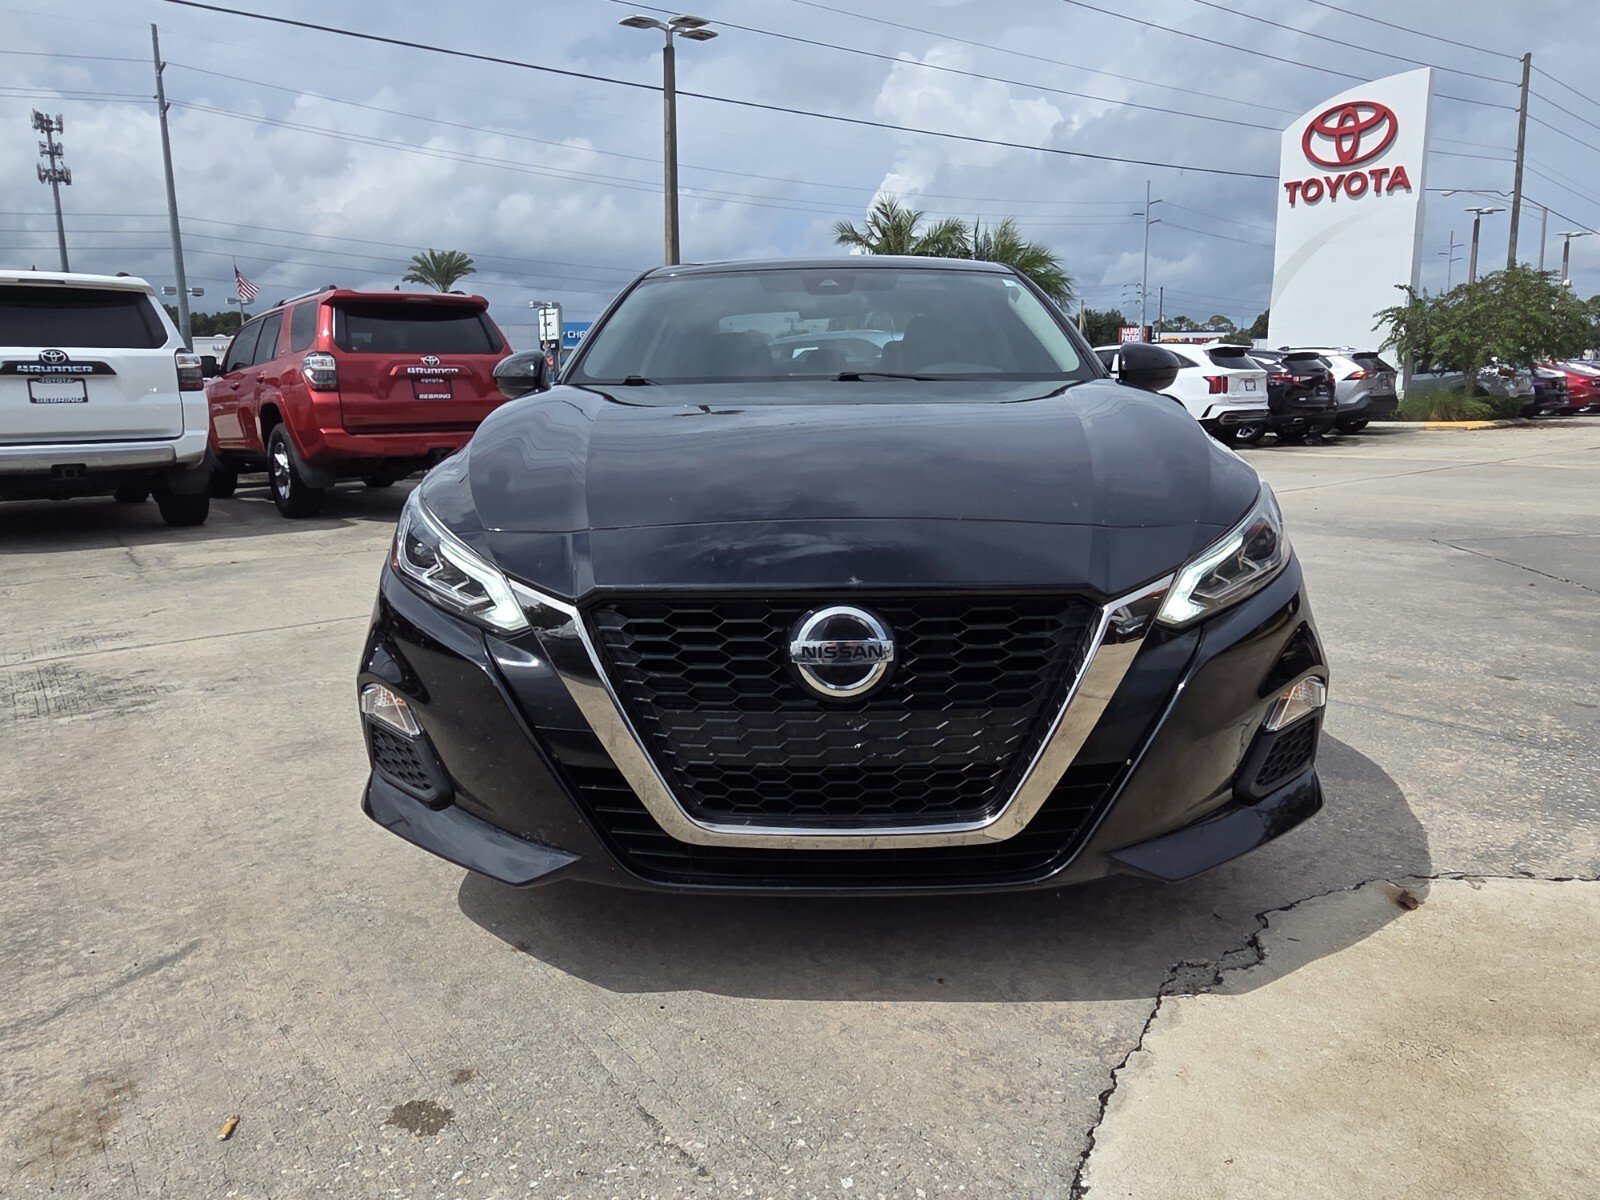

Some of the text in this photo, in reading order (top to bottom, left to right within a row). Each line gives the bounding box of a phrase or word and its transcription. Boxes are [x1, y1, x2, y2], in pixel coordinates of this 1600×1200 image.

[1284, 165, 1412, 205] TOYOTA
[16, 364, 93, 373] 4RUNNER
[801, 645, 882, 659] NISSAN
